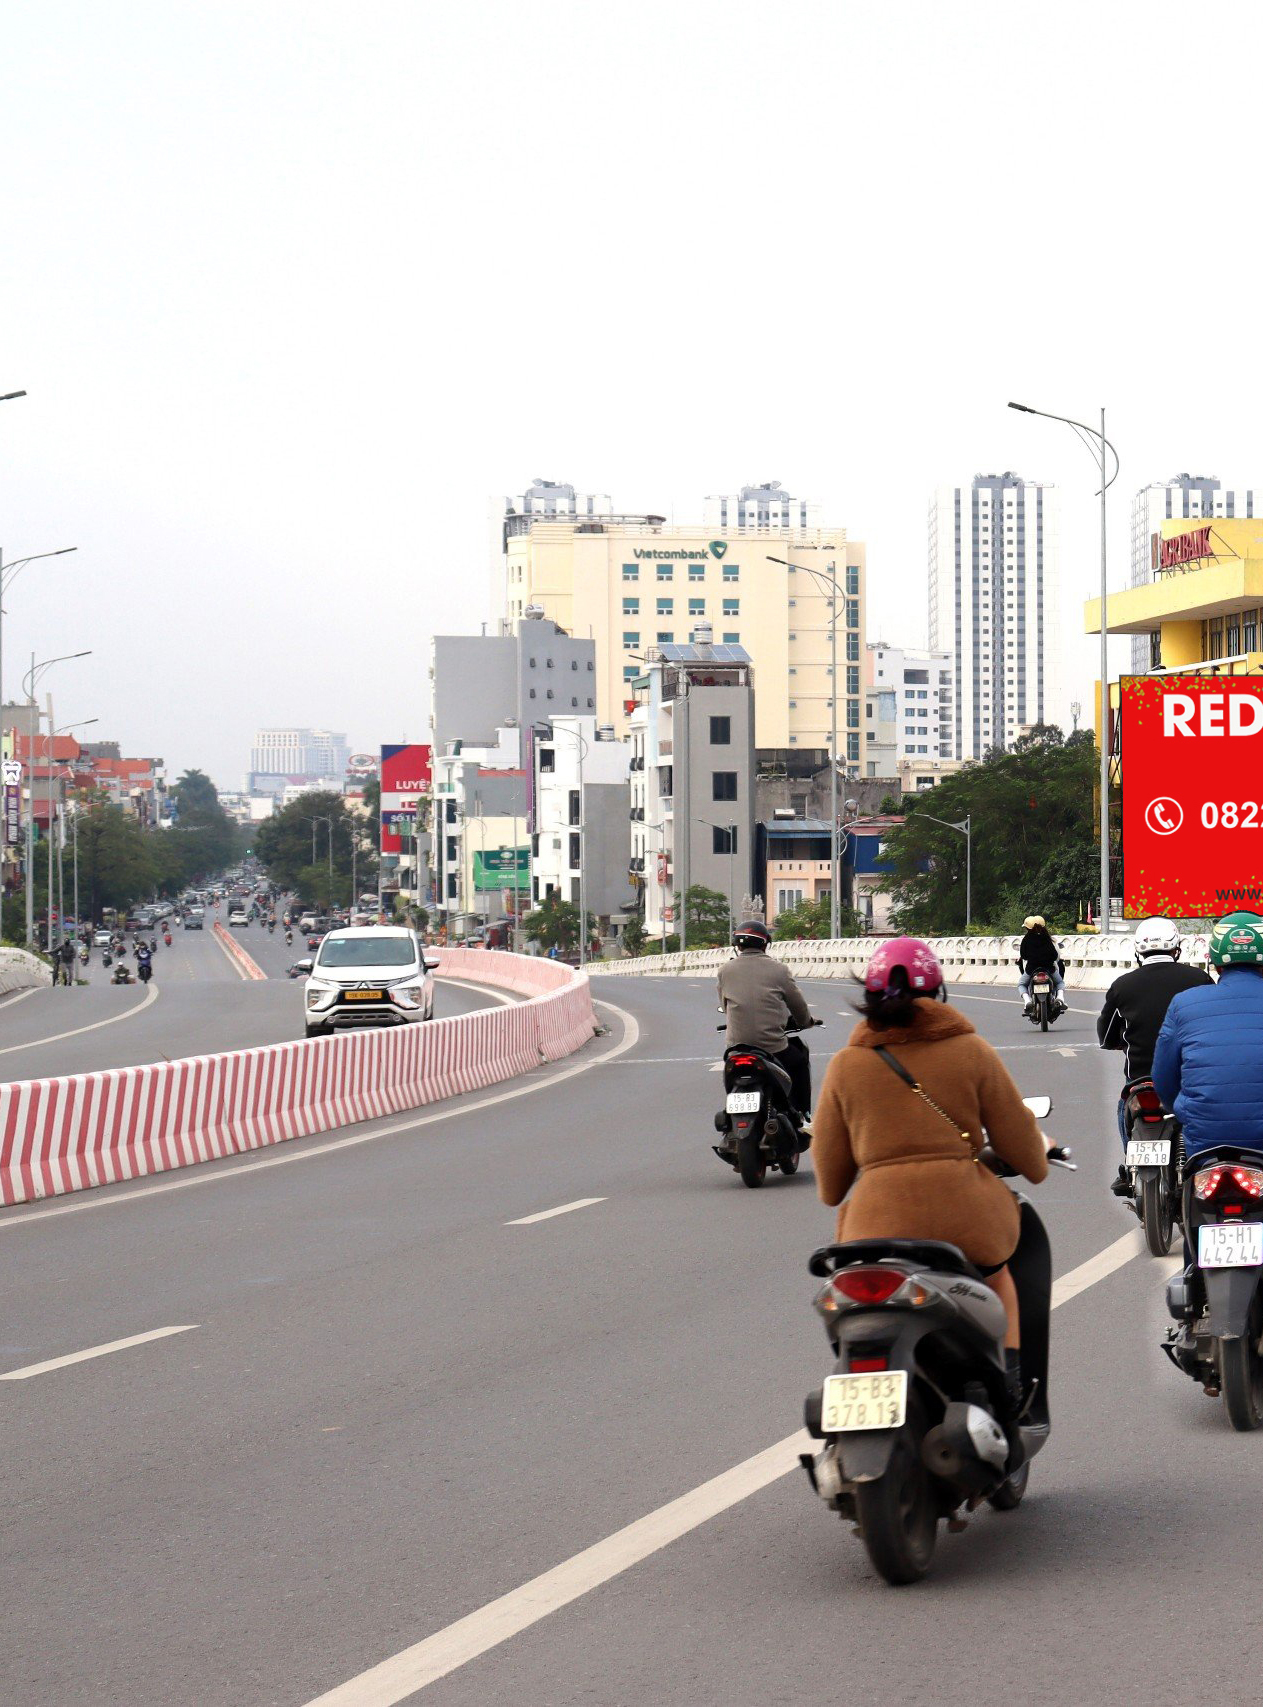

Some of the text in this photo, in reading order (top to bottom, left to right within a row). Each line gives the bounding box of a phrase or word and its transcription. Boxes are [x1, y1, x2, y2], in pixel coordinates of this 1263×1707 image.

[633, 548, 709, 560] Vietcombank
[1135, 1142, 1163, 1152] 15-K1
[1130, 1153, 1167, 1164] 176.18
[1211, 1226, 1252, 1245] 15-H1
[1203, 1245, 1259, 1265] 442.44
[839, 1376, 895, 1401] 15-B3
